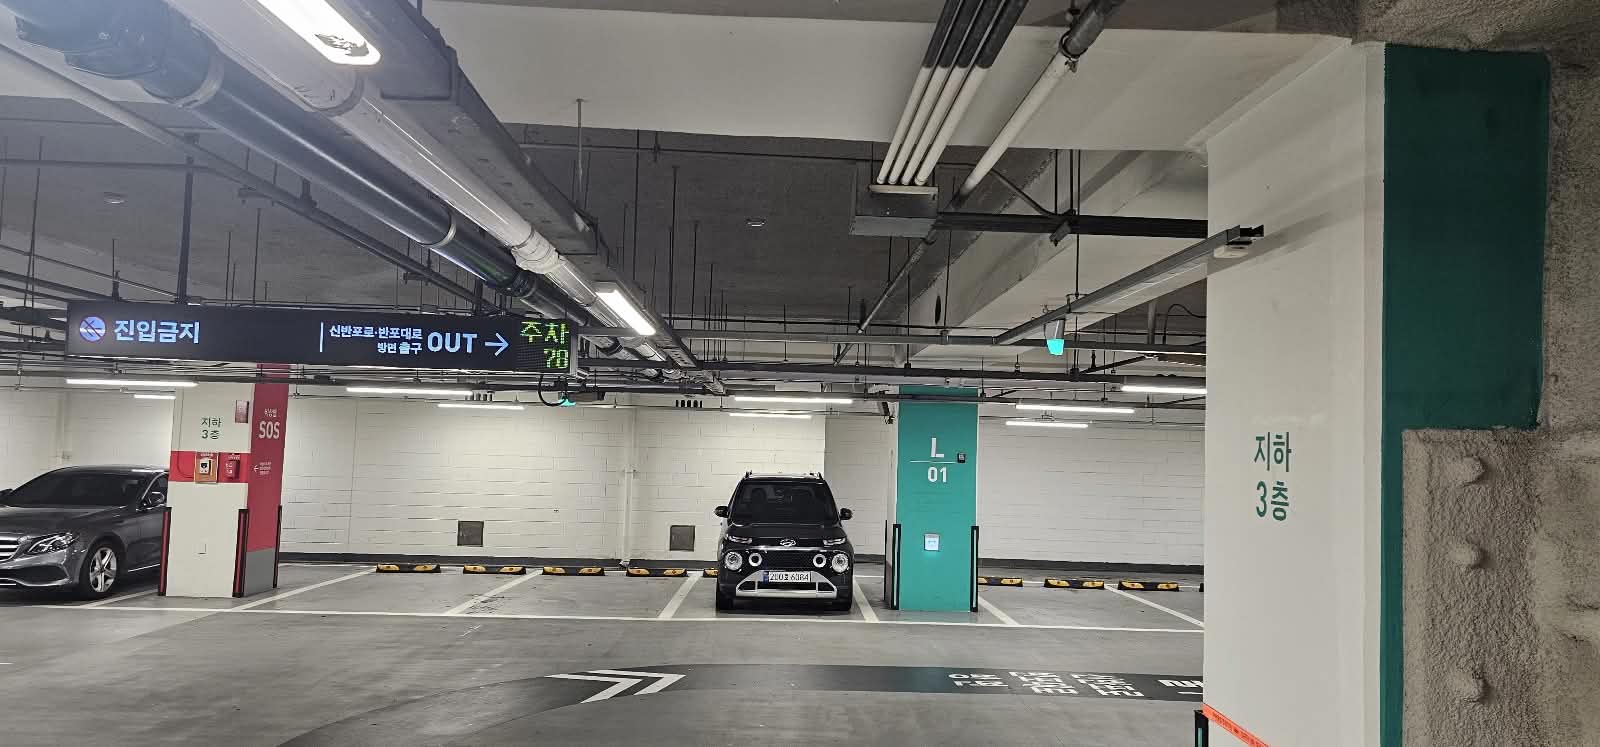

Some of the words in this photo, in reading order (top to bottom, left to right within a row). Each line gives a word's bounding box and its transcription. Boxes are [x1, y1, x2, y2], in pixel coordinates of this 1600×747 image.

[114, 319, 200, 344] 진입금지
[427, 331, 478, 353] OUT
[520, 321, 570, 345] 주차
[377, 341, 397, 354] 방면
[398, 341, 423, 355] 출구
[201, 417, 222, 428] 지하
[258, 420, 281, 440] SOS
[201, 429, 219, 440] 3층
[930, 437, 945, 458] L
[1254, 431, 1292, 473] 지하
[927, 466, 947, 483] 01
[1256, 480, 1290, 522] 3층
